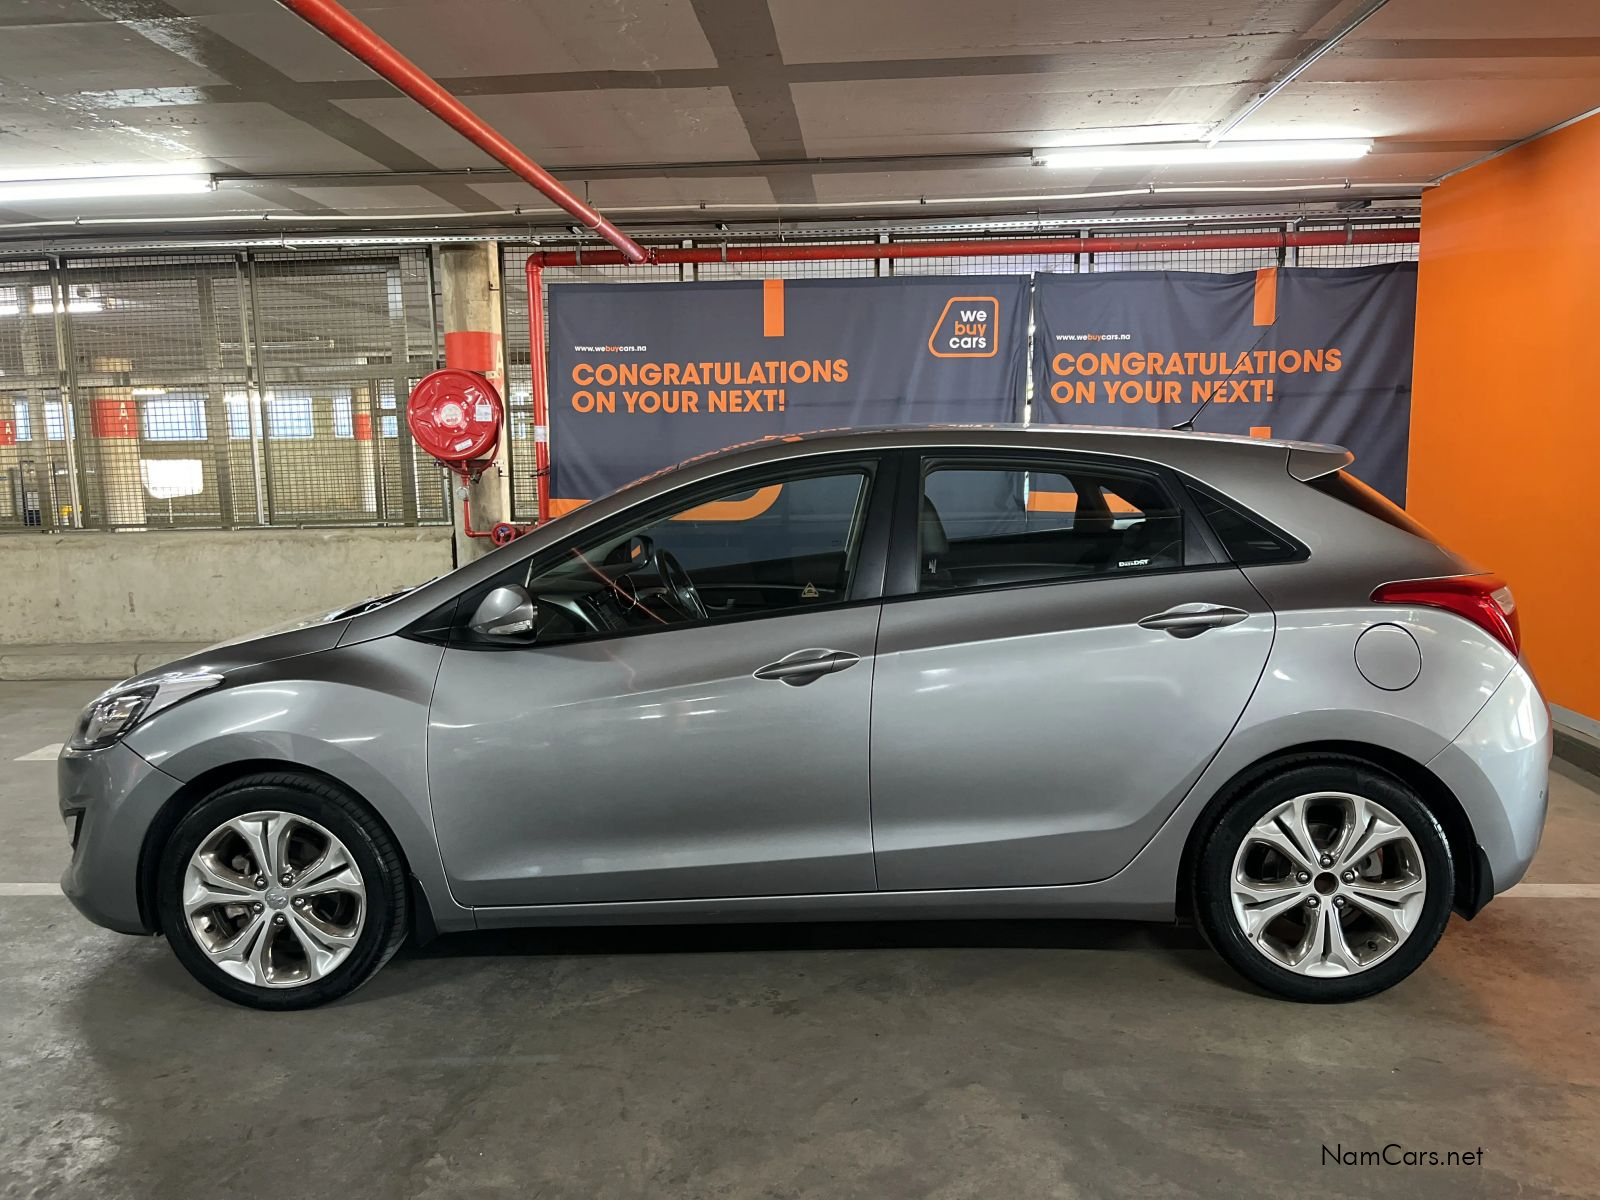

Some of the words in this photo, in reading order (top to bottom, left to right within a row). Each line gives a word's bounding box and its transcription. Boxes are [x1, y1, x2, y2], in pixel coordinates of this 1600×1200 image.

[960, 310, 987, 322] we
[954, 320, 987, 337] buy
[1056, 332, 1131, 342] www.webuycars.na
[574, 345, 647, 353] www.webuycars.na
[949, 336, 987, 349] cars
[1052, 348, 1342, 376] CONGRATULATIONS
[572, 358, 849, 386] CONGRATULATIONS
[1050, 381, 1096, 404] ON
[1103, 381, 1182, 404] YOUR
[1191, 379, 1274, 404] NEXT!
[571, 390, 616, 413] ON
[622, 390, 699, 413] YOUR
[708, 389, 785, 413] NEXT!
[119, 402, 129, 420] A
